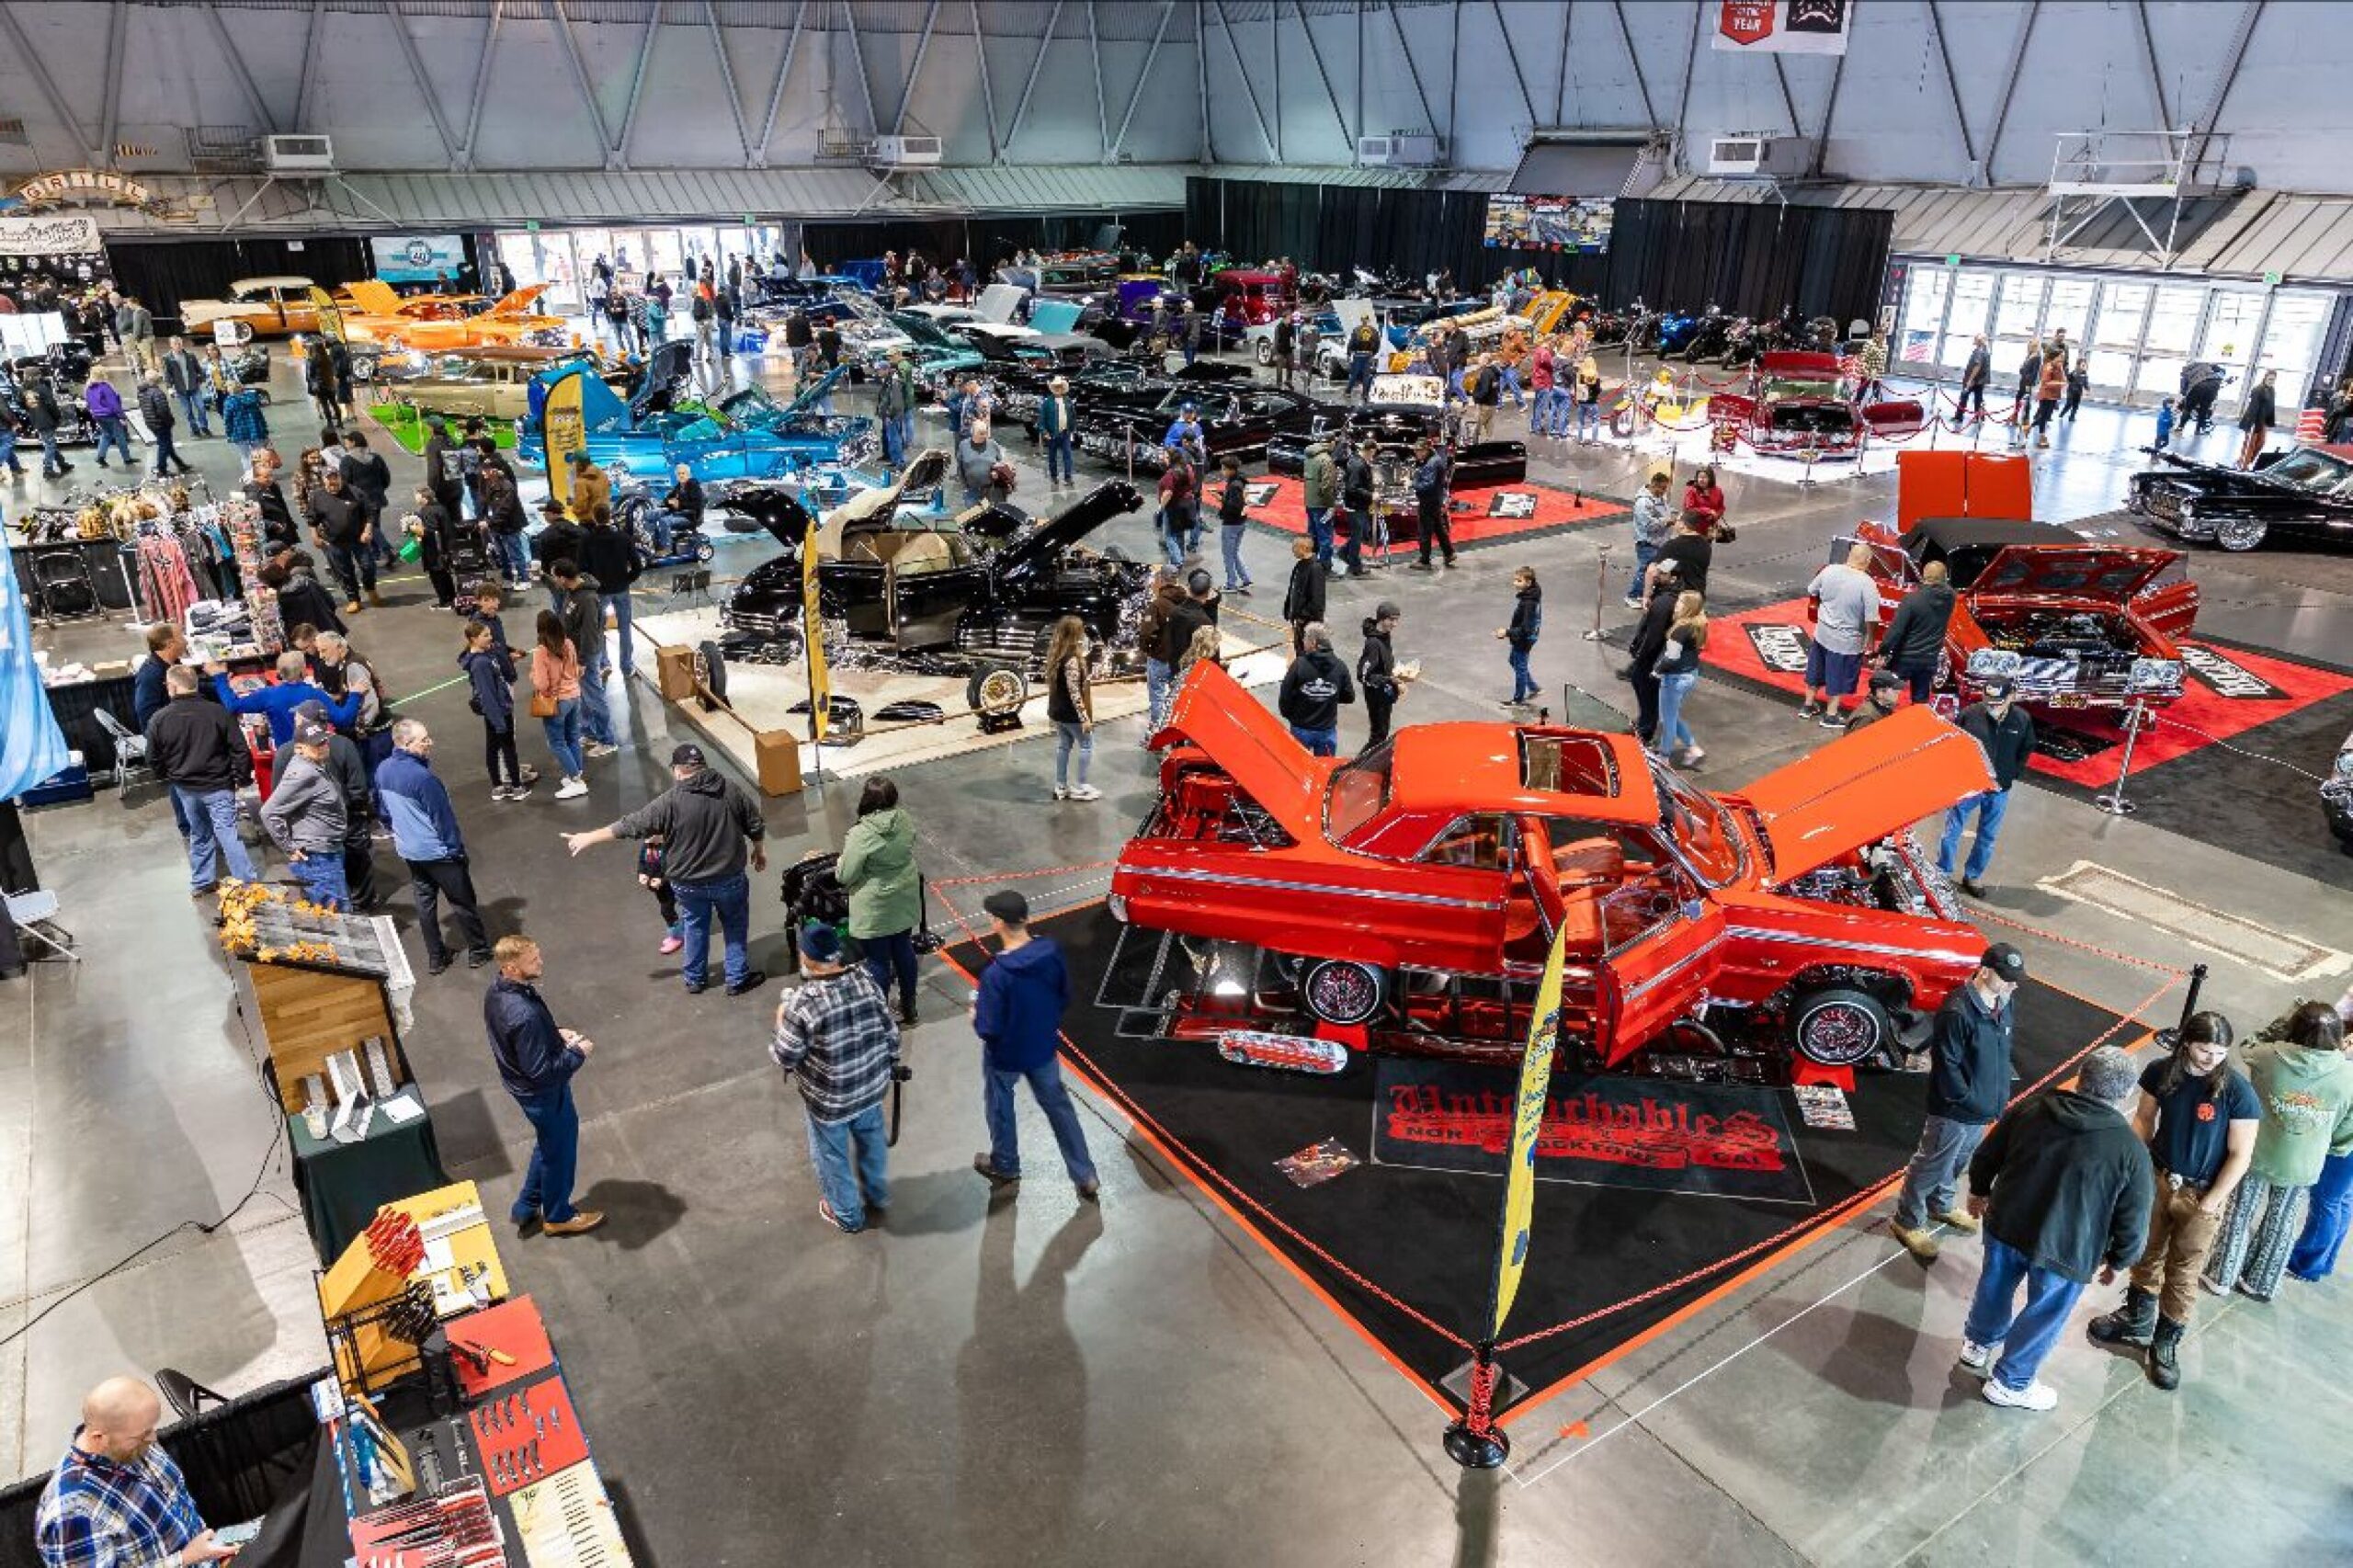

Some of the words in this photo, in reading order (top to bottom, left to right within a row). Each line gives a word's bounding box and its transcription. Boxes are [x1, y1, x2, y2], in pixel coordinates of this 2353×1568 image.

[1733, 17, 1762, 32] YEAR
[27, 174, 142, 199] GRILL
[1406, 1127, 1463, 1140] NOR
